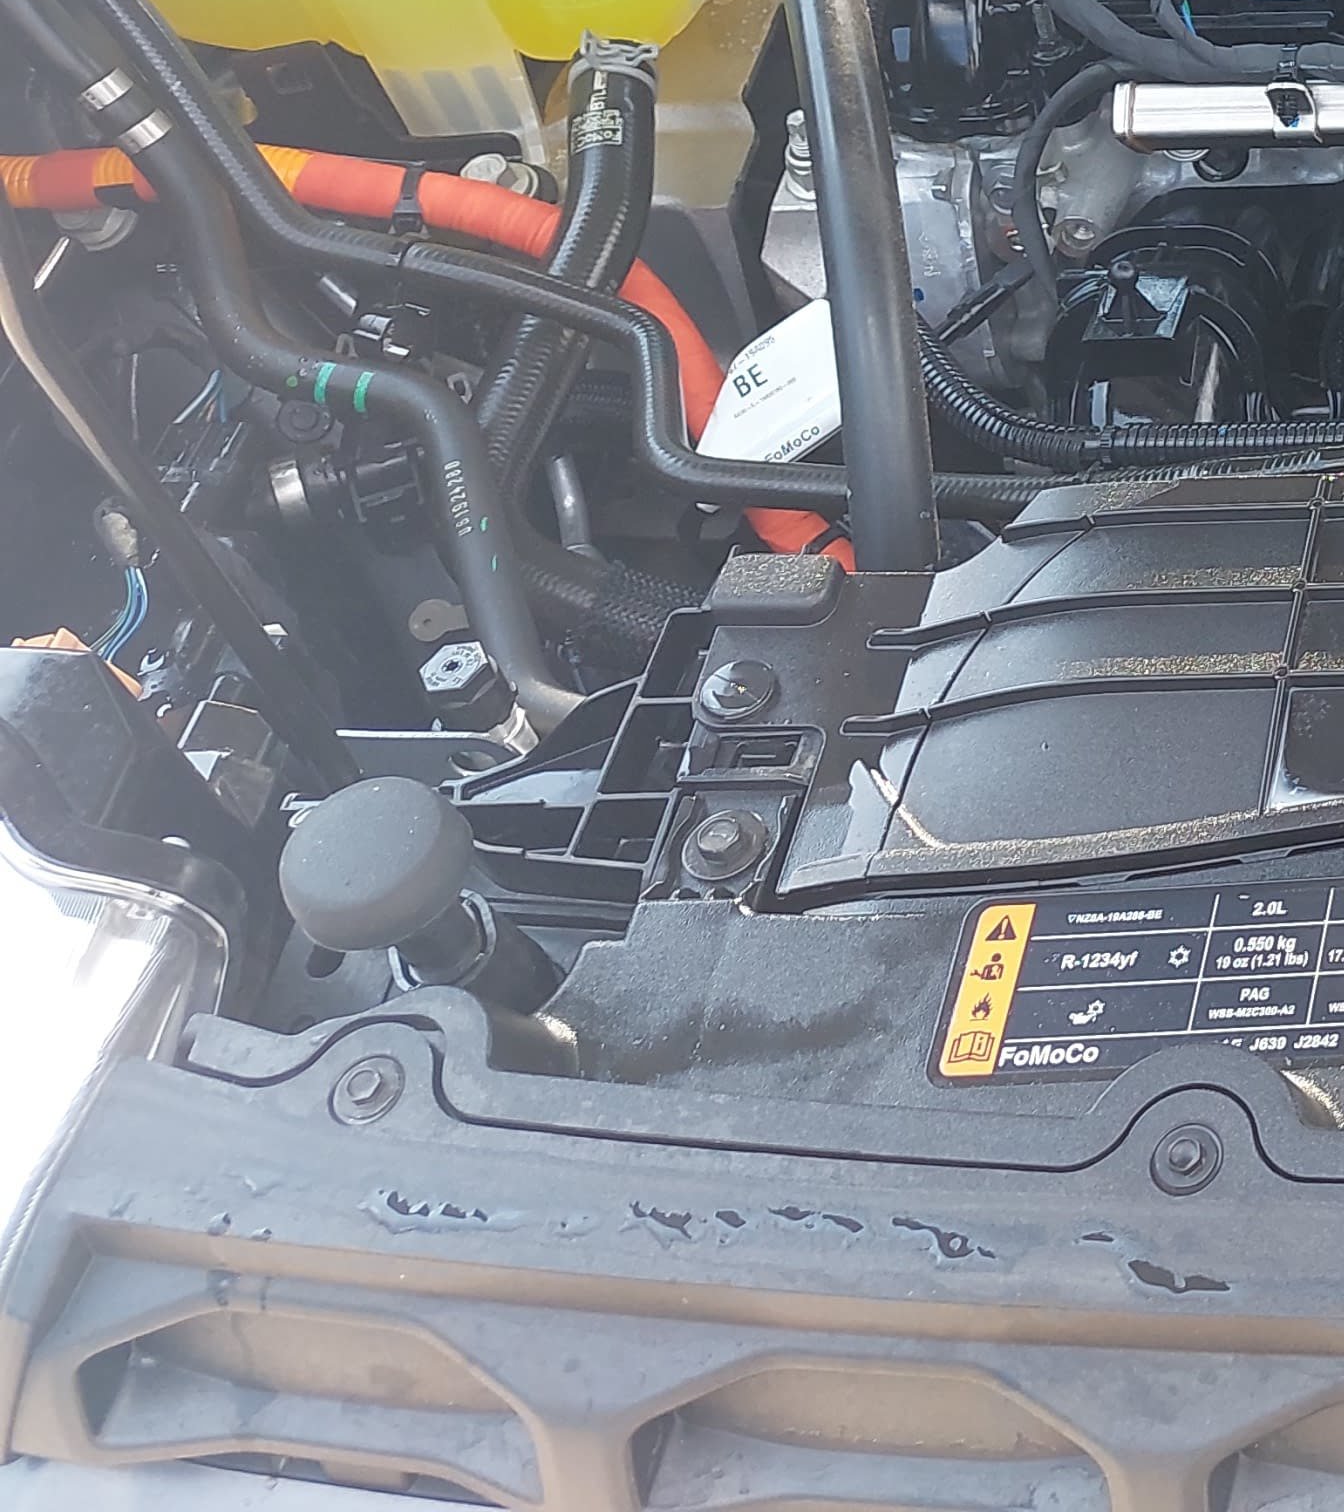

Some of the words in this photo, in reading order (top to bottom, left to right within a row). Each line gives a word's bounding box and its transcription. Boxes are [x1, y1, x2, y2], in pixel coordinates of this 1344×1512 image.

[732, 363, 768, 398] BE
[1252, 901, 1287, 917] 2.0L
[1233, 936, 1272, 952] 0.550
[1276, 934, 1297, 952] kg
[1060, 951, 1138, 971] R-1234yf
[1215, 955, 1230, 969] 19
[1232, 958, 1250, 969] oz
[1239, 987, 1270, 1001] PAG
[1248, 1036, 1287, 1052] J639
[1293, 1033, 1340, 1049] J2842
[998, 1043, 1099, 1067] FoMoCo
